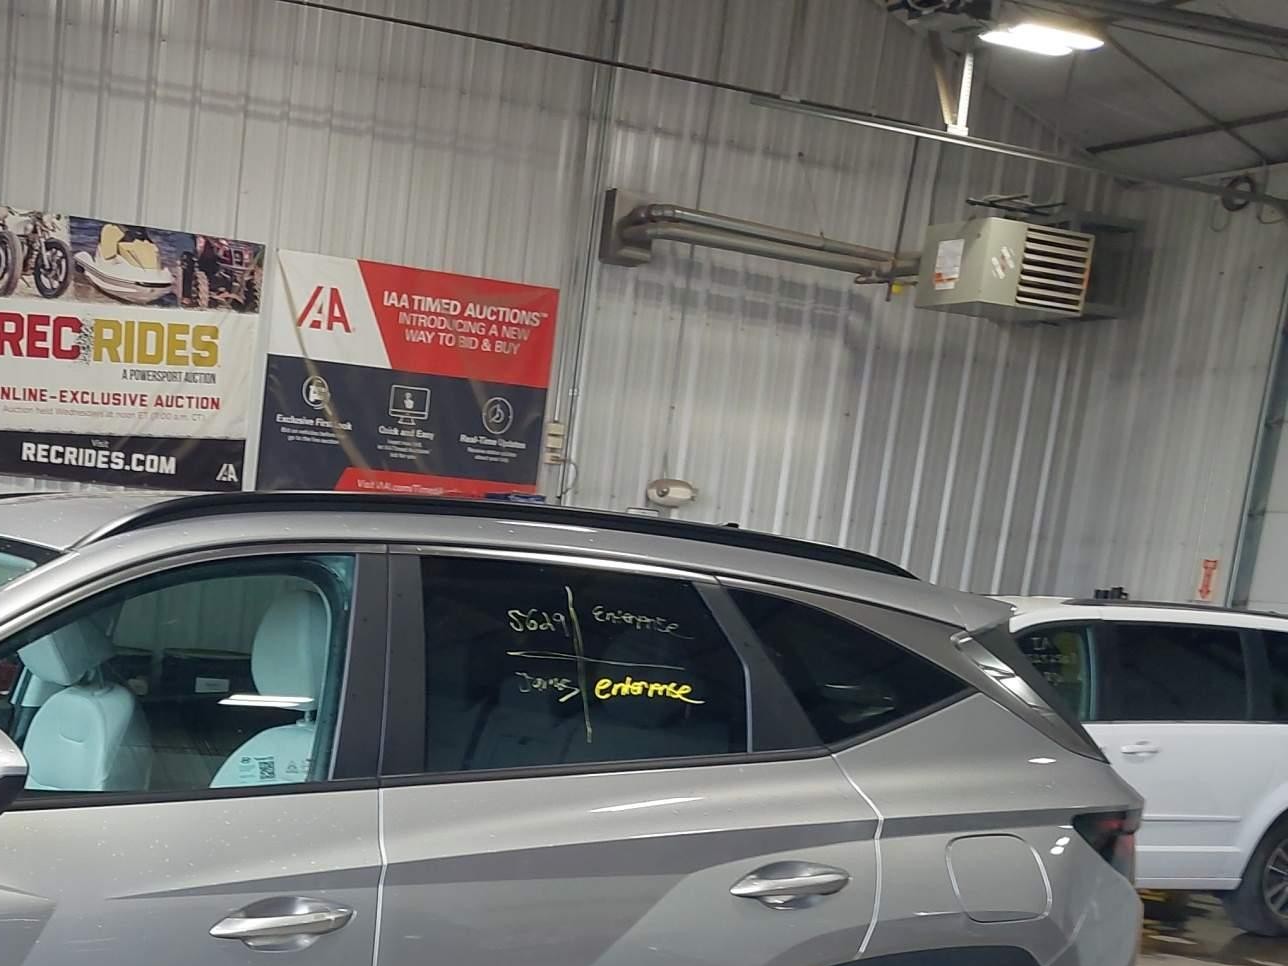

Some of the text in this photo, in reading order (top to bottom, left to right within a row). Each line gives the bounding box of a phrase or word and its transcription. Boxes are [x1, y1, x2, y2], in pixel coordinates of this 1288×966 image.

[382, 290, 410, 310] IAA
[412, 295, 461, 315] TIMED
[398, 312, 531, 341] INTRODUCING A NEW
[92, 318, 221, 367] RIDES
[405, 328, 521, 355] WAY TO BID & BUY
[121, 368, 217, 384] A POWERSPORT AUCTION
[152, 396, 221, 410] AUCTION
[399, 428, 416, 437] and
[21, 440, 177, 475] RECRIDES.COM
